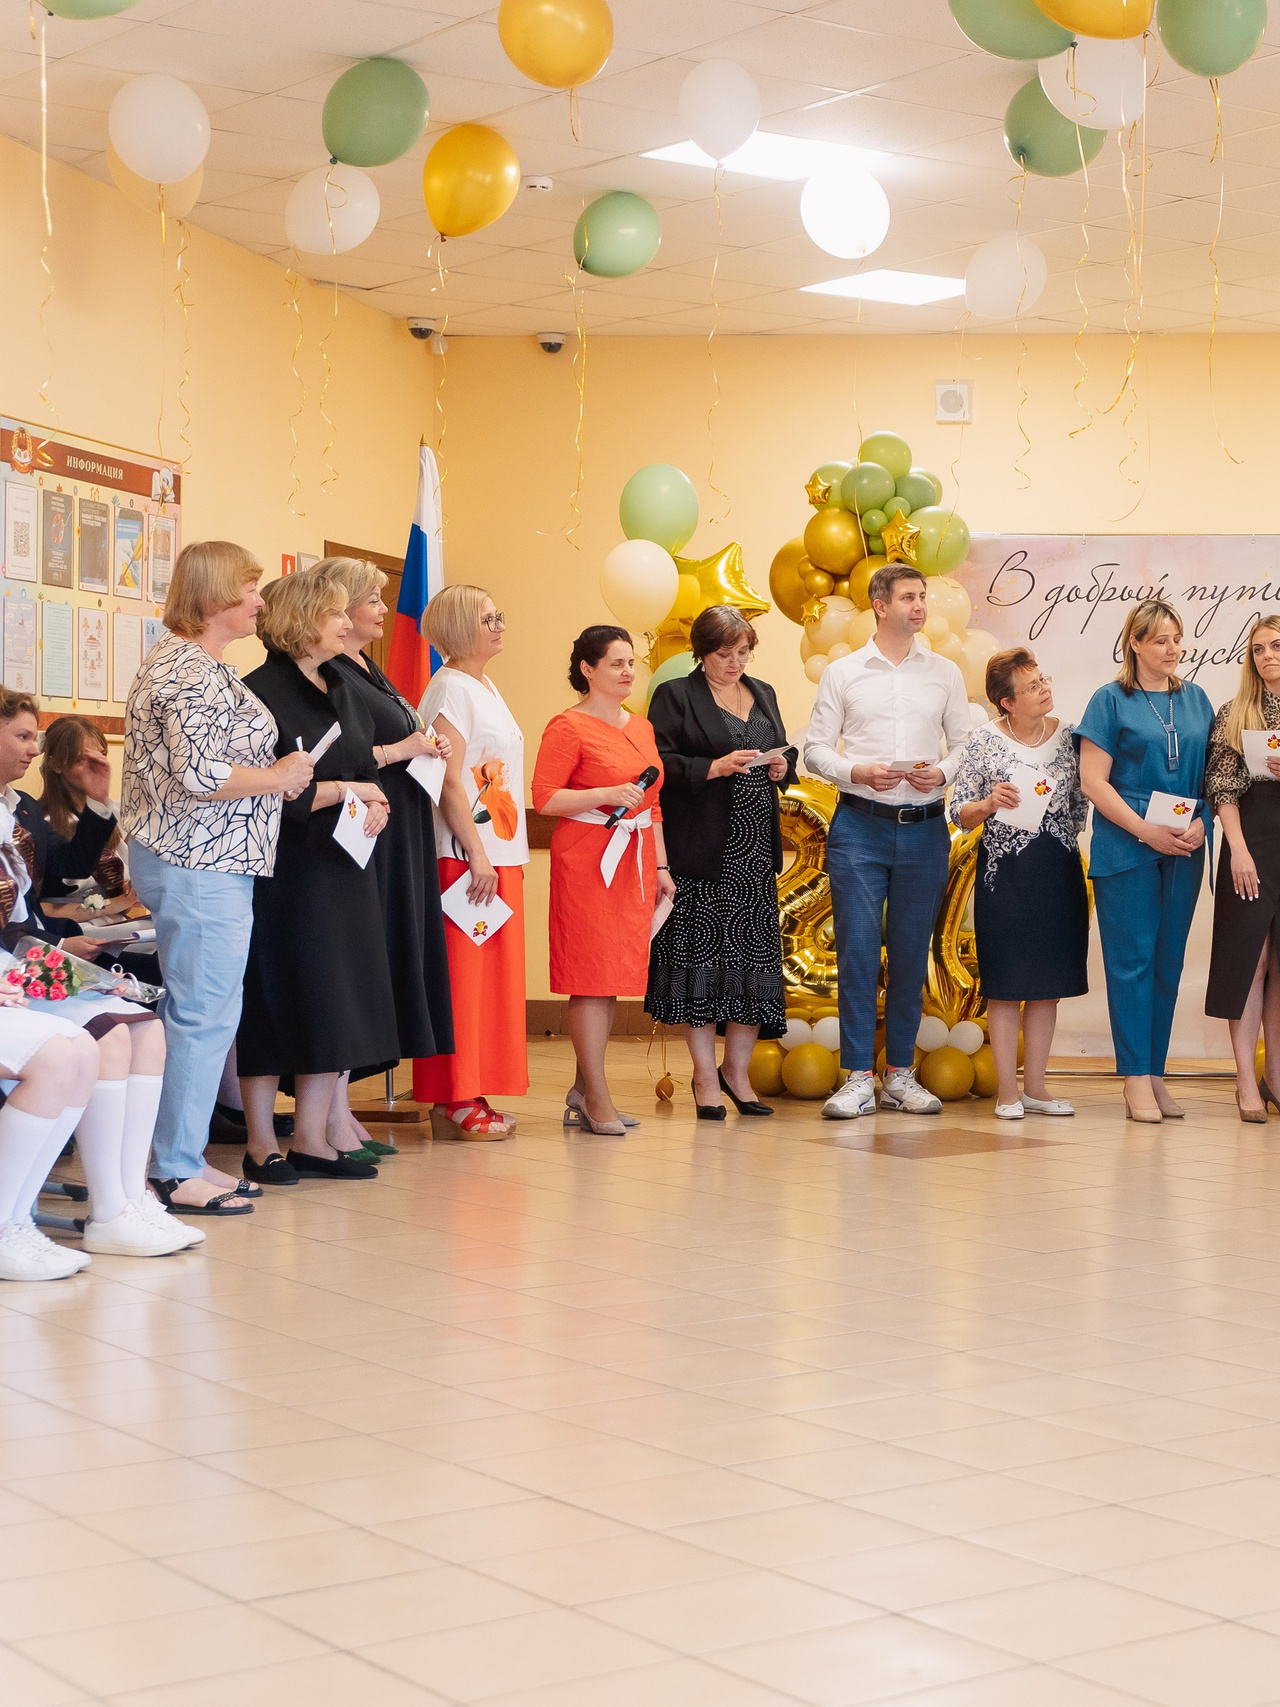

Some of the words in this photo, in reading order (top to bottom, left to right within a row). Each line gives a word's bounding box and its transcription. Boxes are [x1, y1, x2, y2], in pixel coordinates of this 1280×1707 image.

[66, 455, 124, 480] ИНФОРМАЦИЯ
[986, 550, 1036, 607] В
[1028, 562, 1173, 641] добрый
